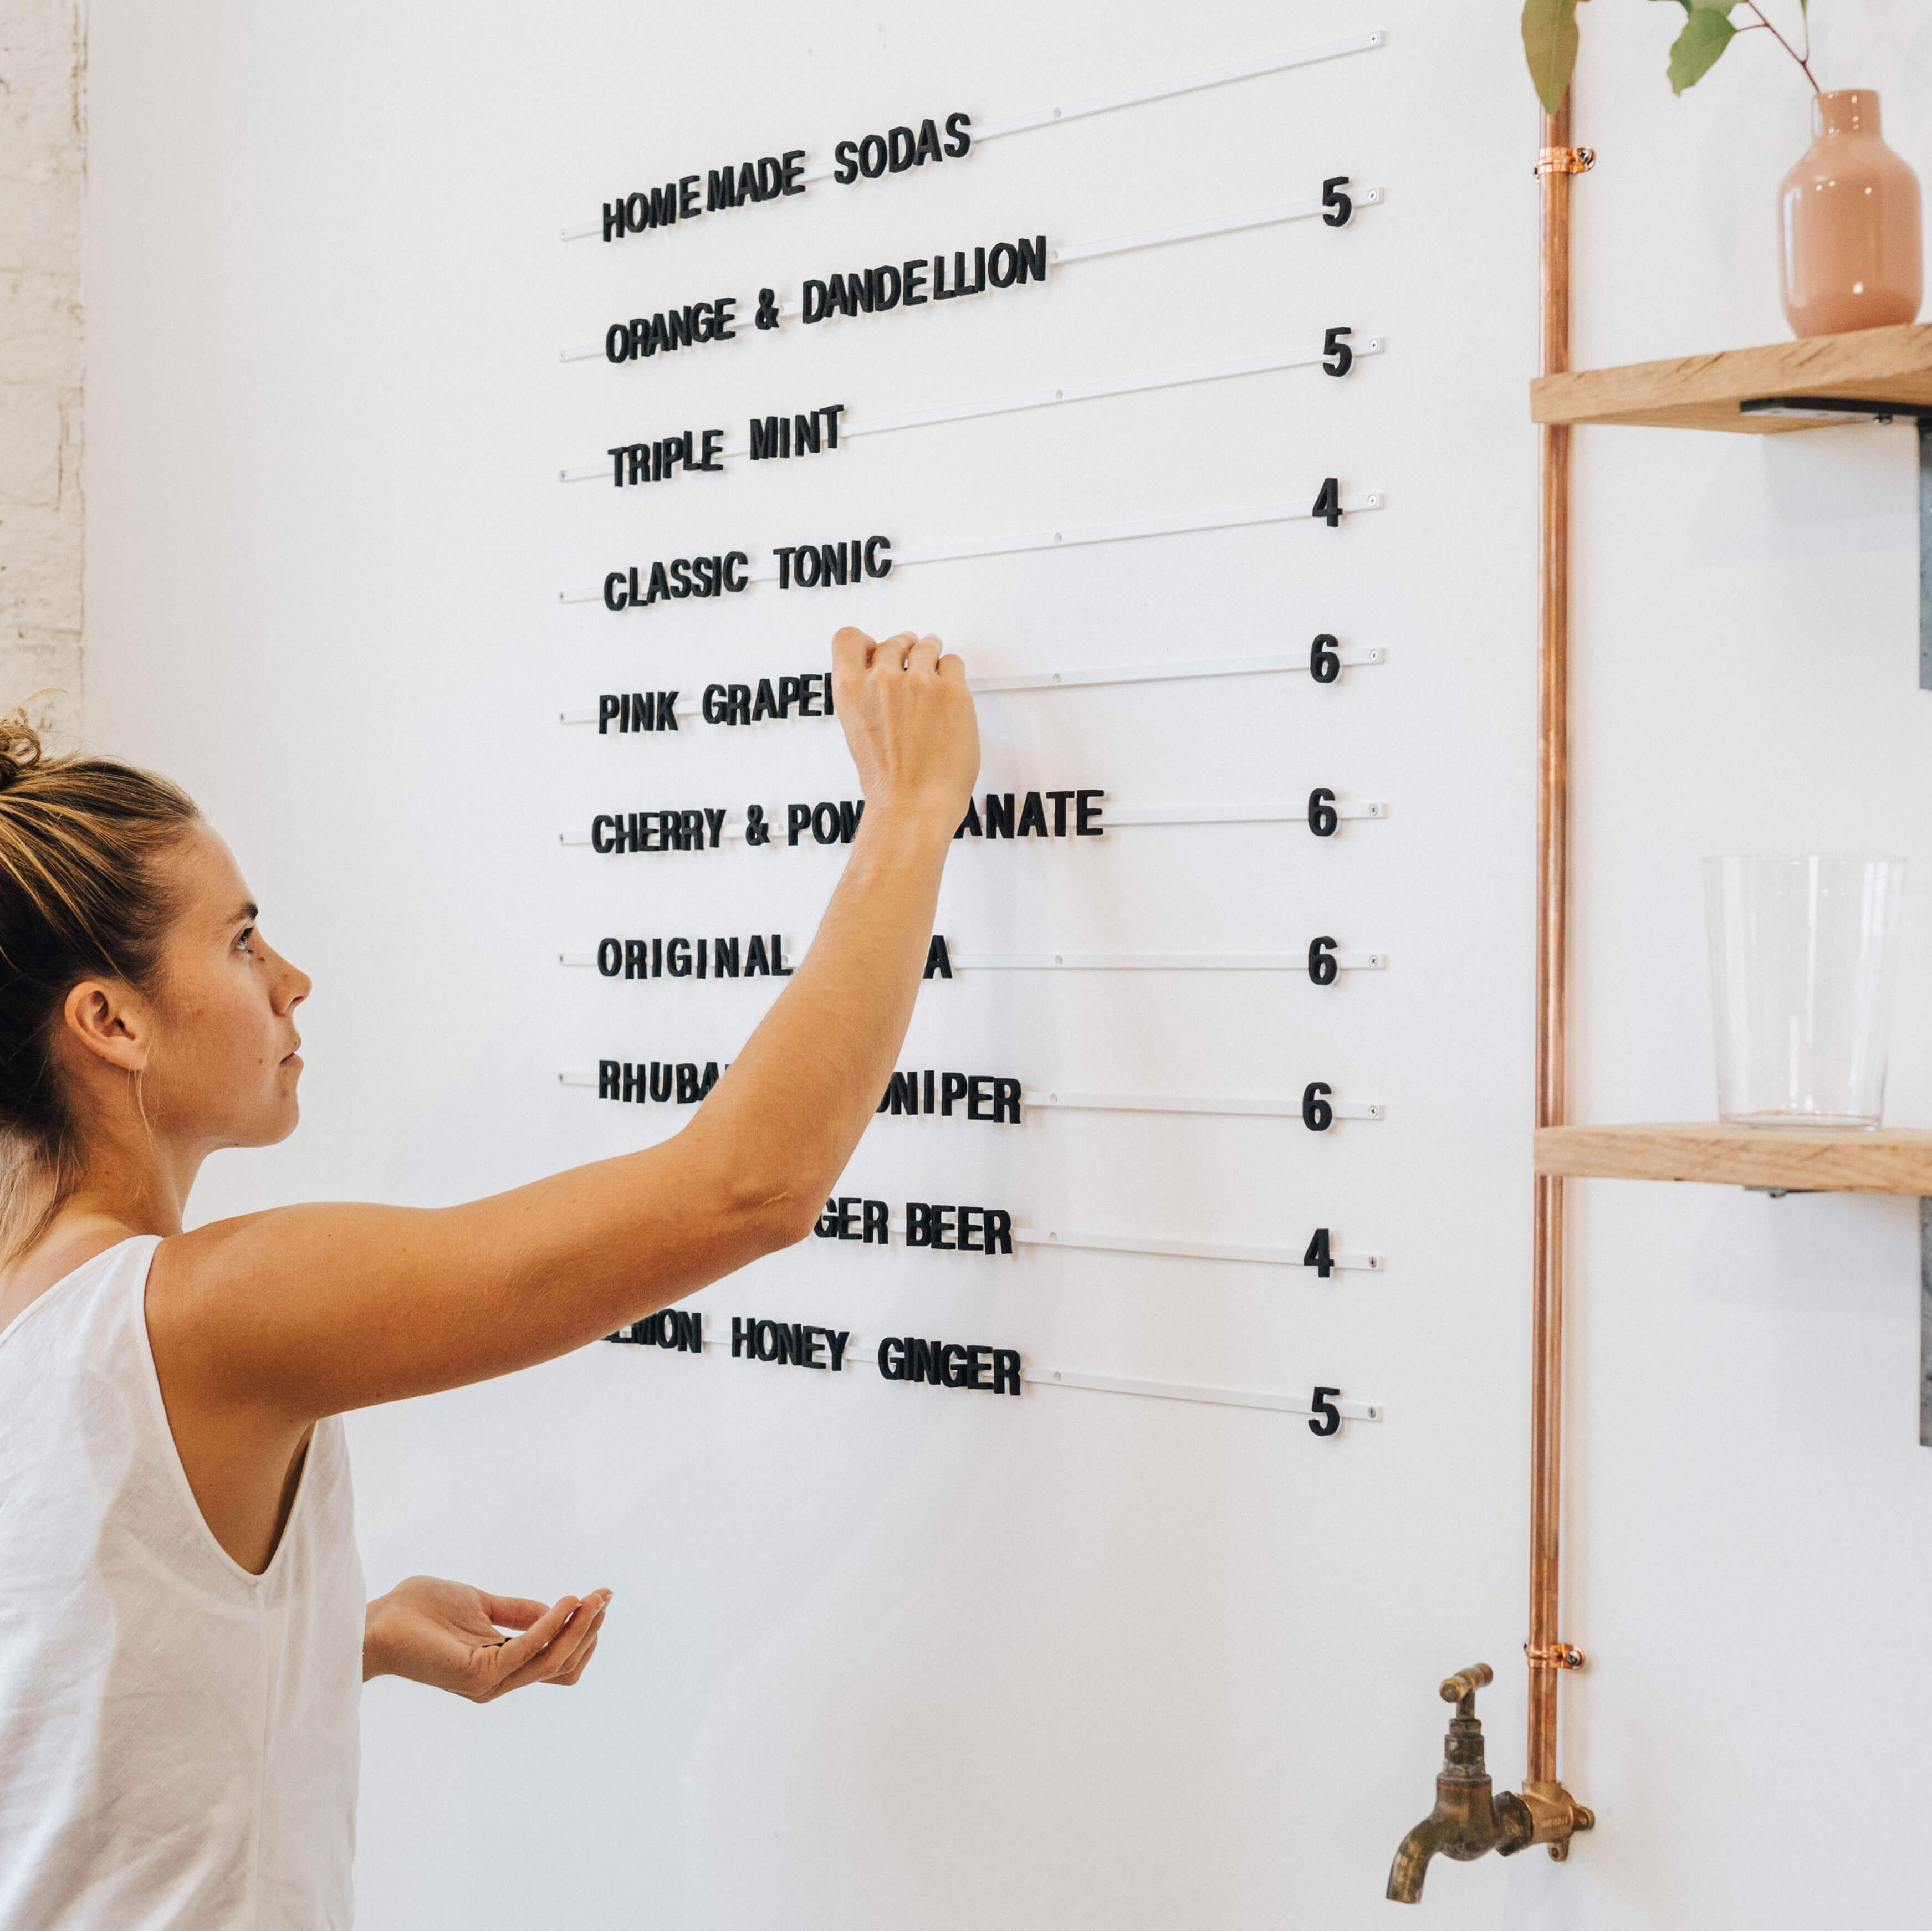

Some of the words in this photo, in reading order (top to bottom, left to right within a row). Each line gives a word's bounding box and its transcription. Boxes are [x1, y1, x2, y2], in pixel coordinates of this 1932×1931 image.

[603, 150, 806, 242] HOMEMADE
[834, 112, 972, 185] SODAS
[1322, 176, 1352, 227] 5
[606, 298, 737, 363] ORANGE
[755, 288, 780, 330] &
[802, 235, 1047, 324] DANDELLION
[1323, 327, 1352, 377] 5
[607, 429, 724, 488] TRIPLE
[750, 404, 845, 462] MINT
[1312, 478, 1343, 527] 4
[604, 551, 748, 611] CLASSIC
[773, 535, 892, 590] TONIC
[1310, 634, 1340, 683] 6
[599, 691, 679, 734] PINK
[592, 808, 727, 854] CHERRY
[745, 805, 771, 846] &
[1308, 788, 1338, 837] 6
[597, 934, 794, 980] ORIGINAL
[1308, 936, 1338, 985] 6
[1302, 1082, 1333, 1131] 6
[906, 1202, 1013, 1255] BEER
[1303, 1228, 1335, 1278] 4
[732, 1317, 850, 1371] HONEY
[877, 1337, 1021, 1396] GINGER
[1308, 1387, 1340, 1437] 5
